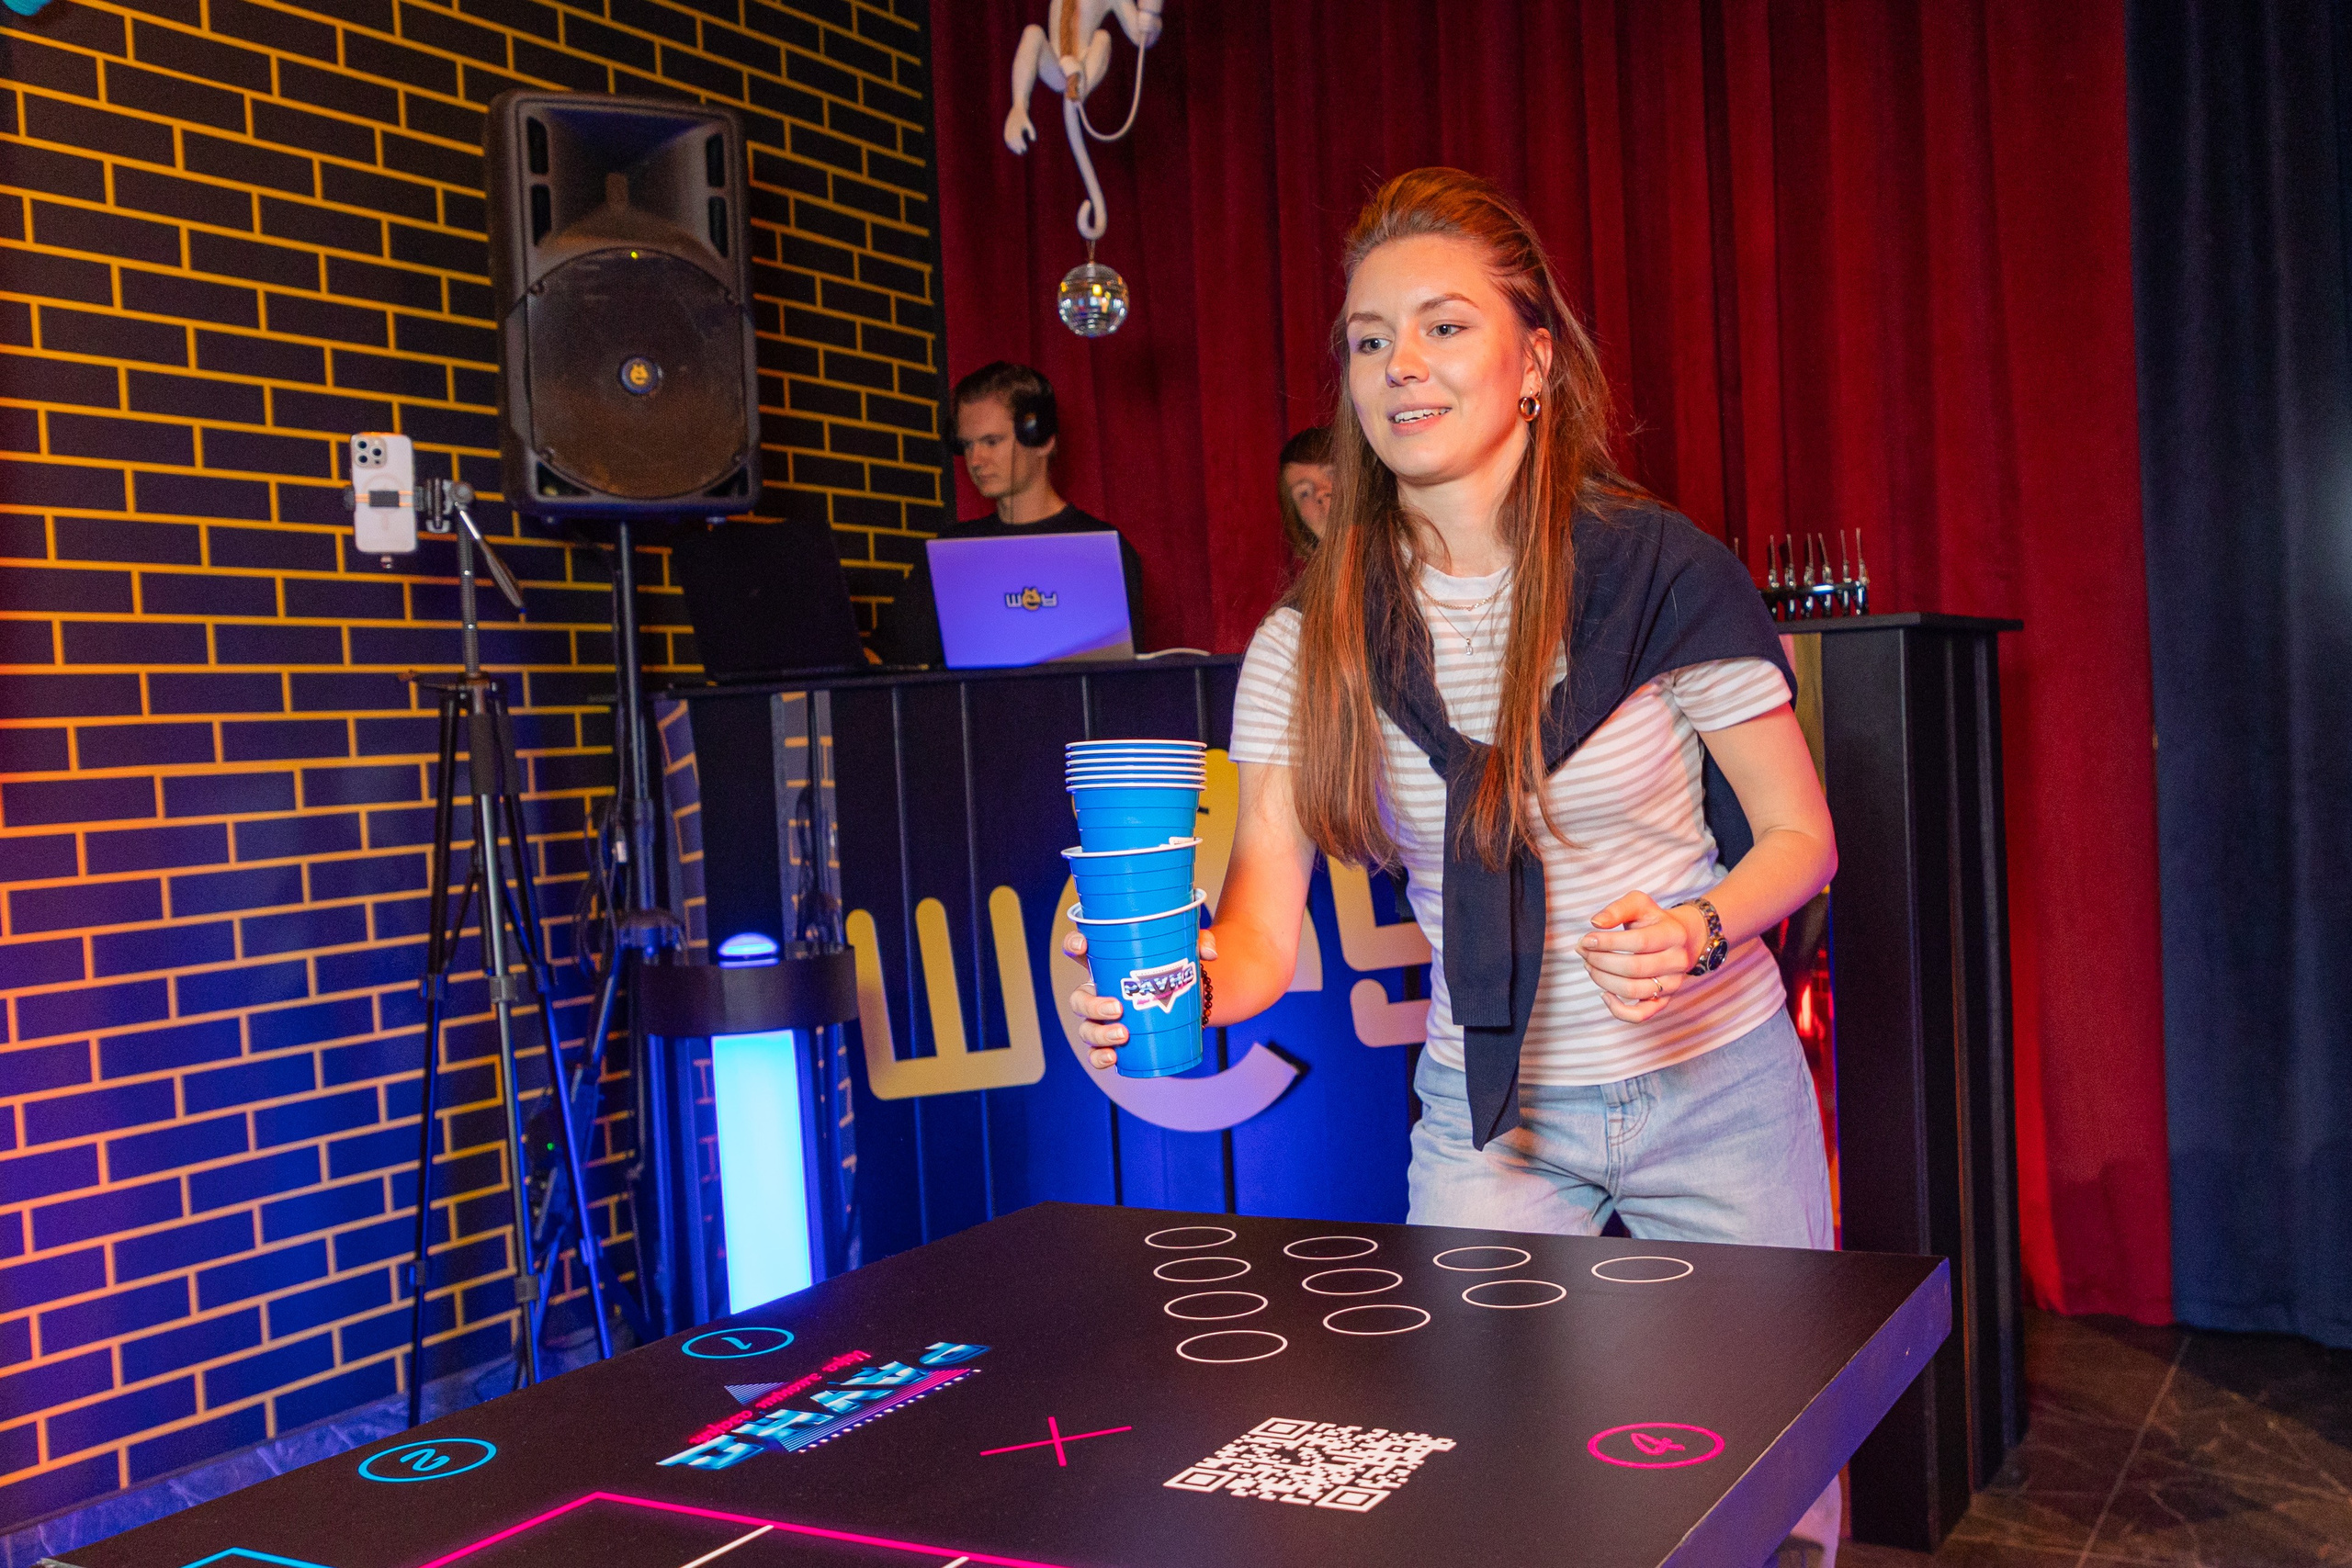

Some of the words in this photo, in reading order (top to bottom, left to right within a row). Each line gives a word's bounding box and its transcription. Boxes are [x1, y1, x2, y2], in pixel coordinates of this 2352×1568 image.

[1124, 966, 1194, 997] РАУНД
[720, 1336, 752, 1350] 1
[655, 1340, 990, 1470] РАУНД
[1630, 1432, 1686, 1456] 4
[399, 1448, 450, 1472] 2
